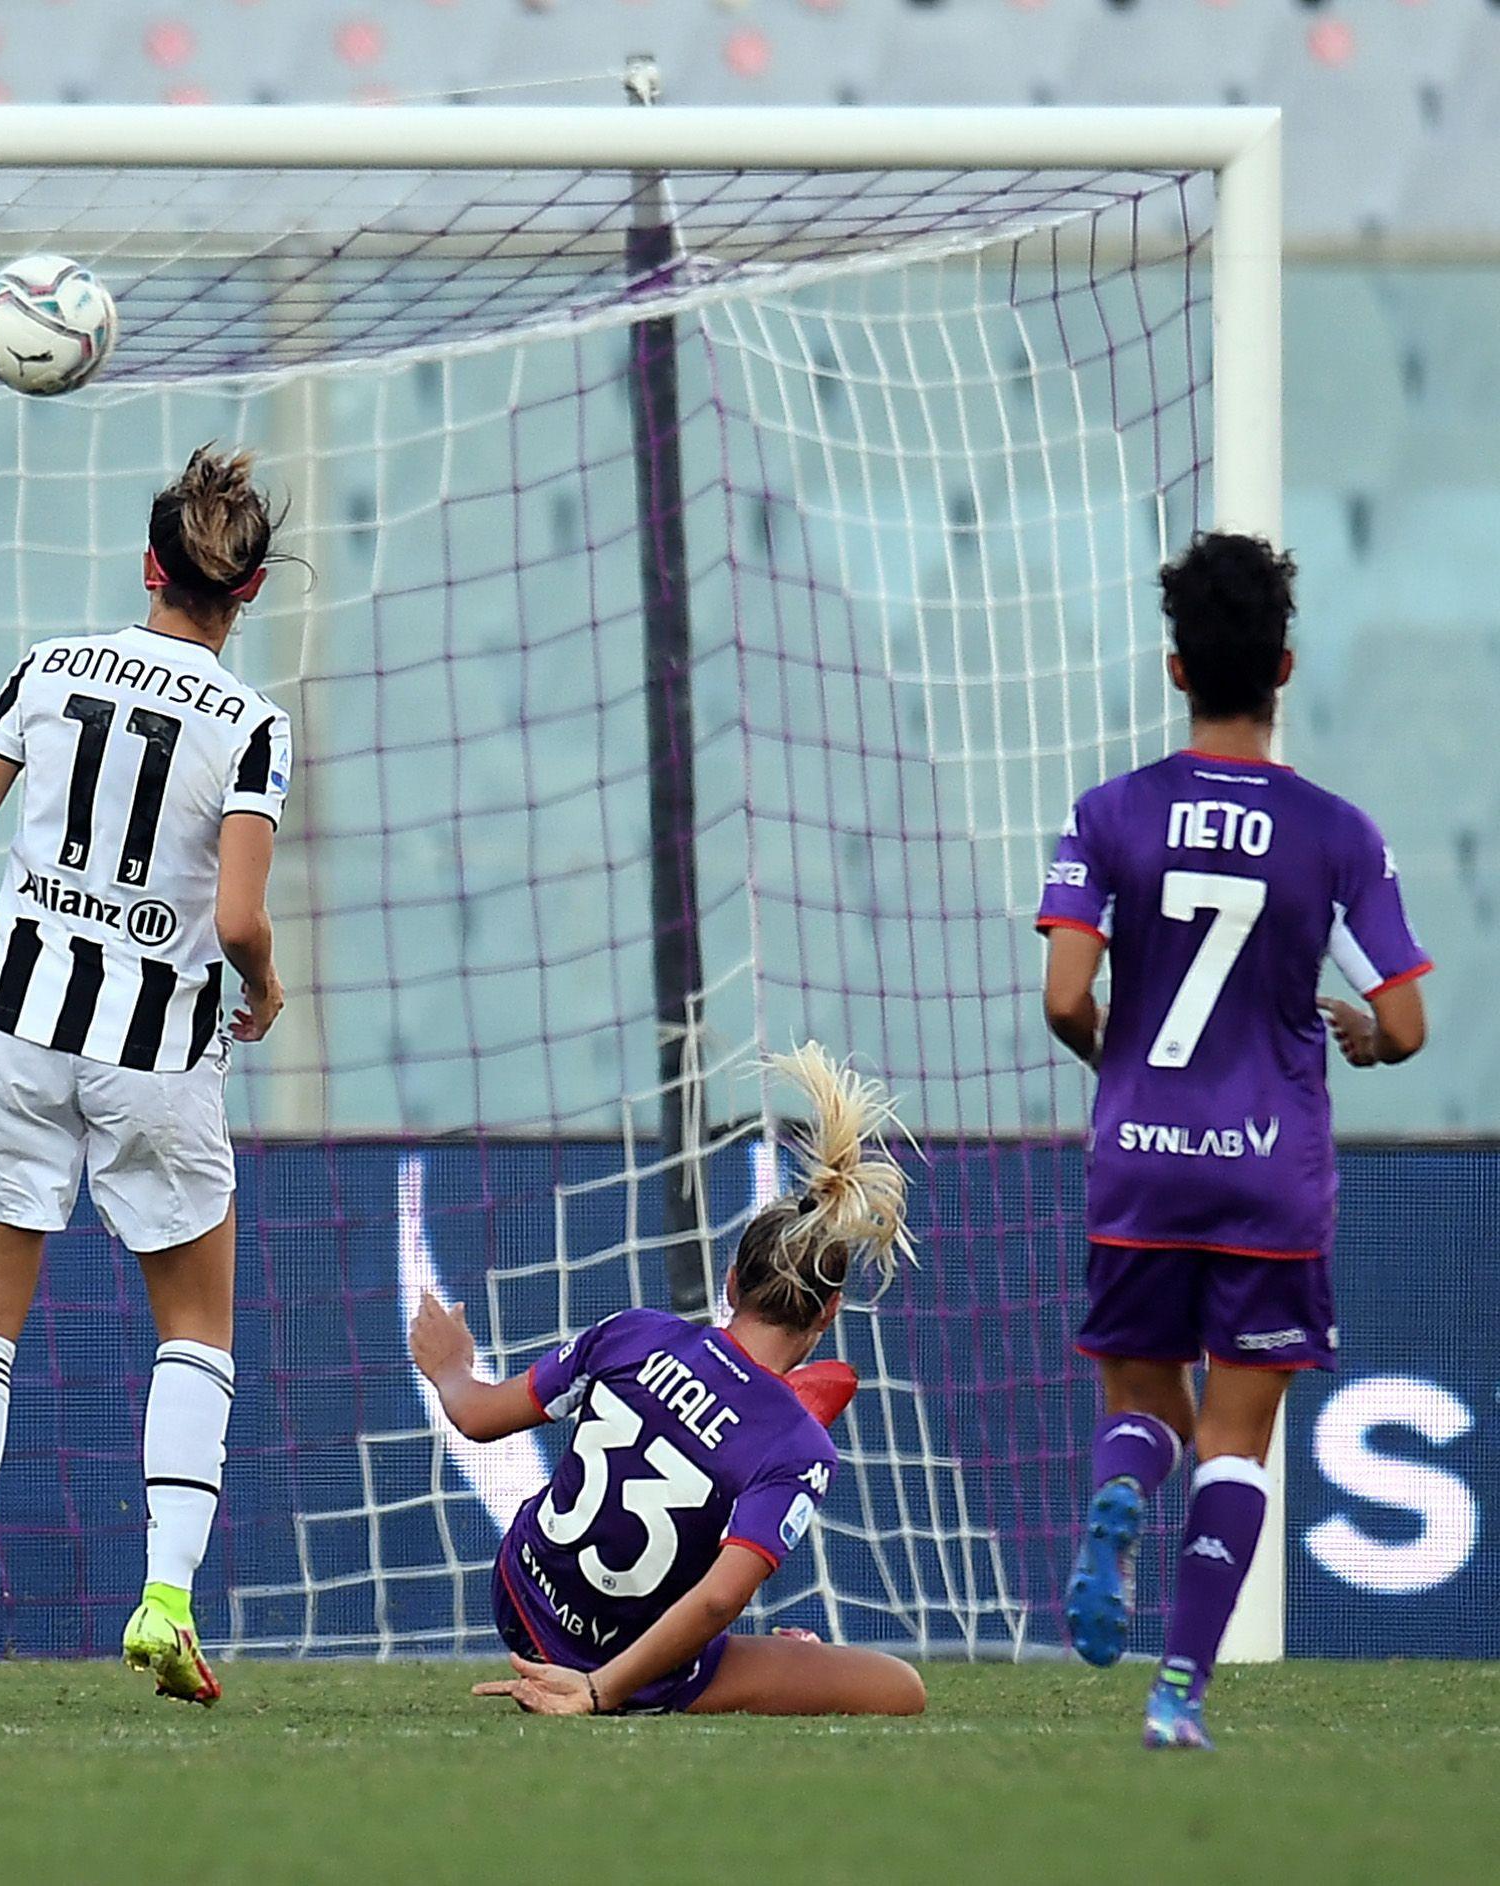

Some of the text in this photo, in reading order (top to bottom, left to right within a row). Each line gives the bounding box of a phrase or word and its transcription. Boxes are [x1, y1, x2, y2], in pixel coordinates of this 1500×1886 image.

[42, 648, 245, 724] BONANSEA
[59, 694, 181, 887] 11
[1167, 800, 1273, 856] NETO
[1147, 870, 1267, 1068] 7
[1118, 1121, 1244, 1157] SYNLAB
[637, 1350, 739, 1449] VITALE
[537, 1381, 713, 1597] 33
[1304, 1376, 1478, 1594] S
[522, 1543, 584, 1636] SYNLAB
